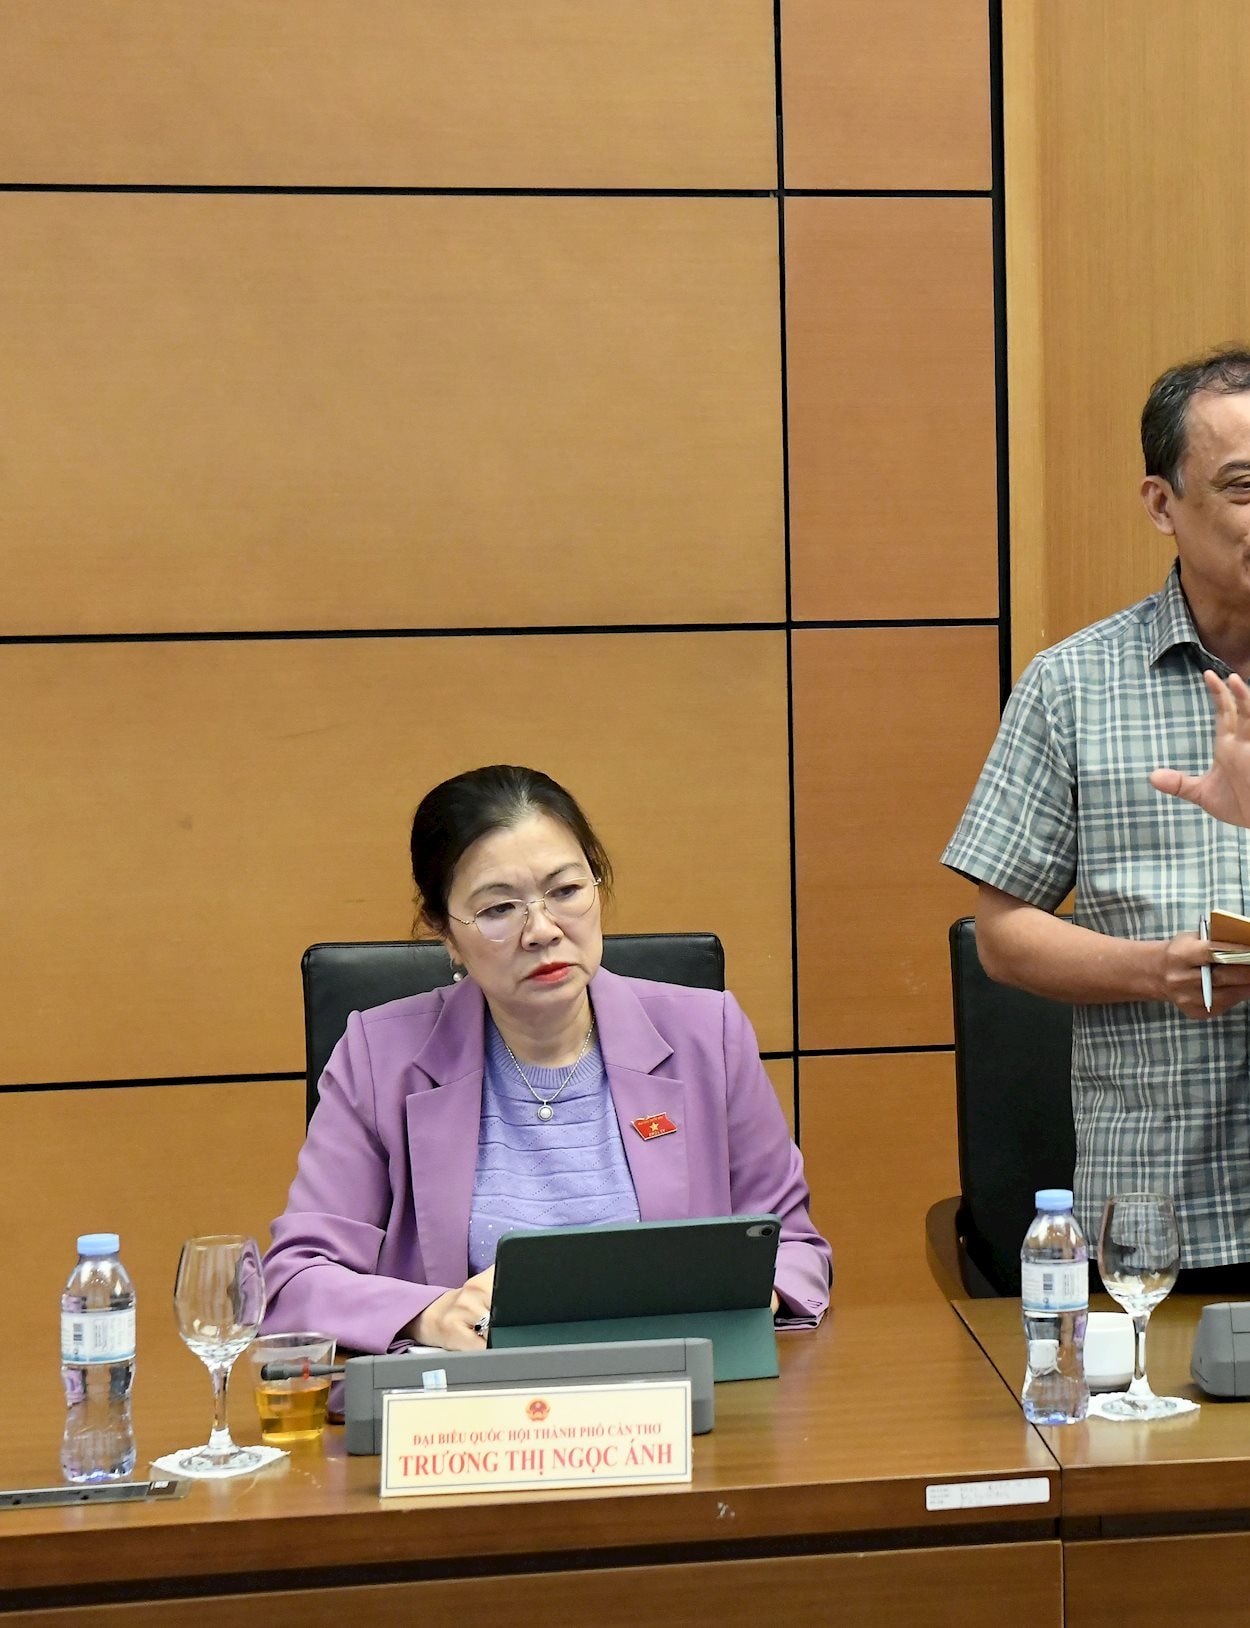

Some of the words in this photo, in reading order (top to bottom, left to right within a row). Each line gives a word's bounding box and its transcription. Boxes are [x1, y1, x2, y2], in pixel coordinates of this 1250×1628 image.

[413, 1433, 434, 1448] ĐẠI
[508, 1428, 530, 1443] HỘI
[399, 1449, 498, 1477] TRƯƠNG
[505, 1448, 544, 1476] THỊ
[552, 1445, 618, 1473] NGỌC
[624, 1438, 672, 1466] ÁNH
